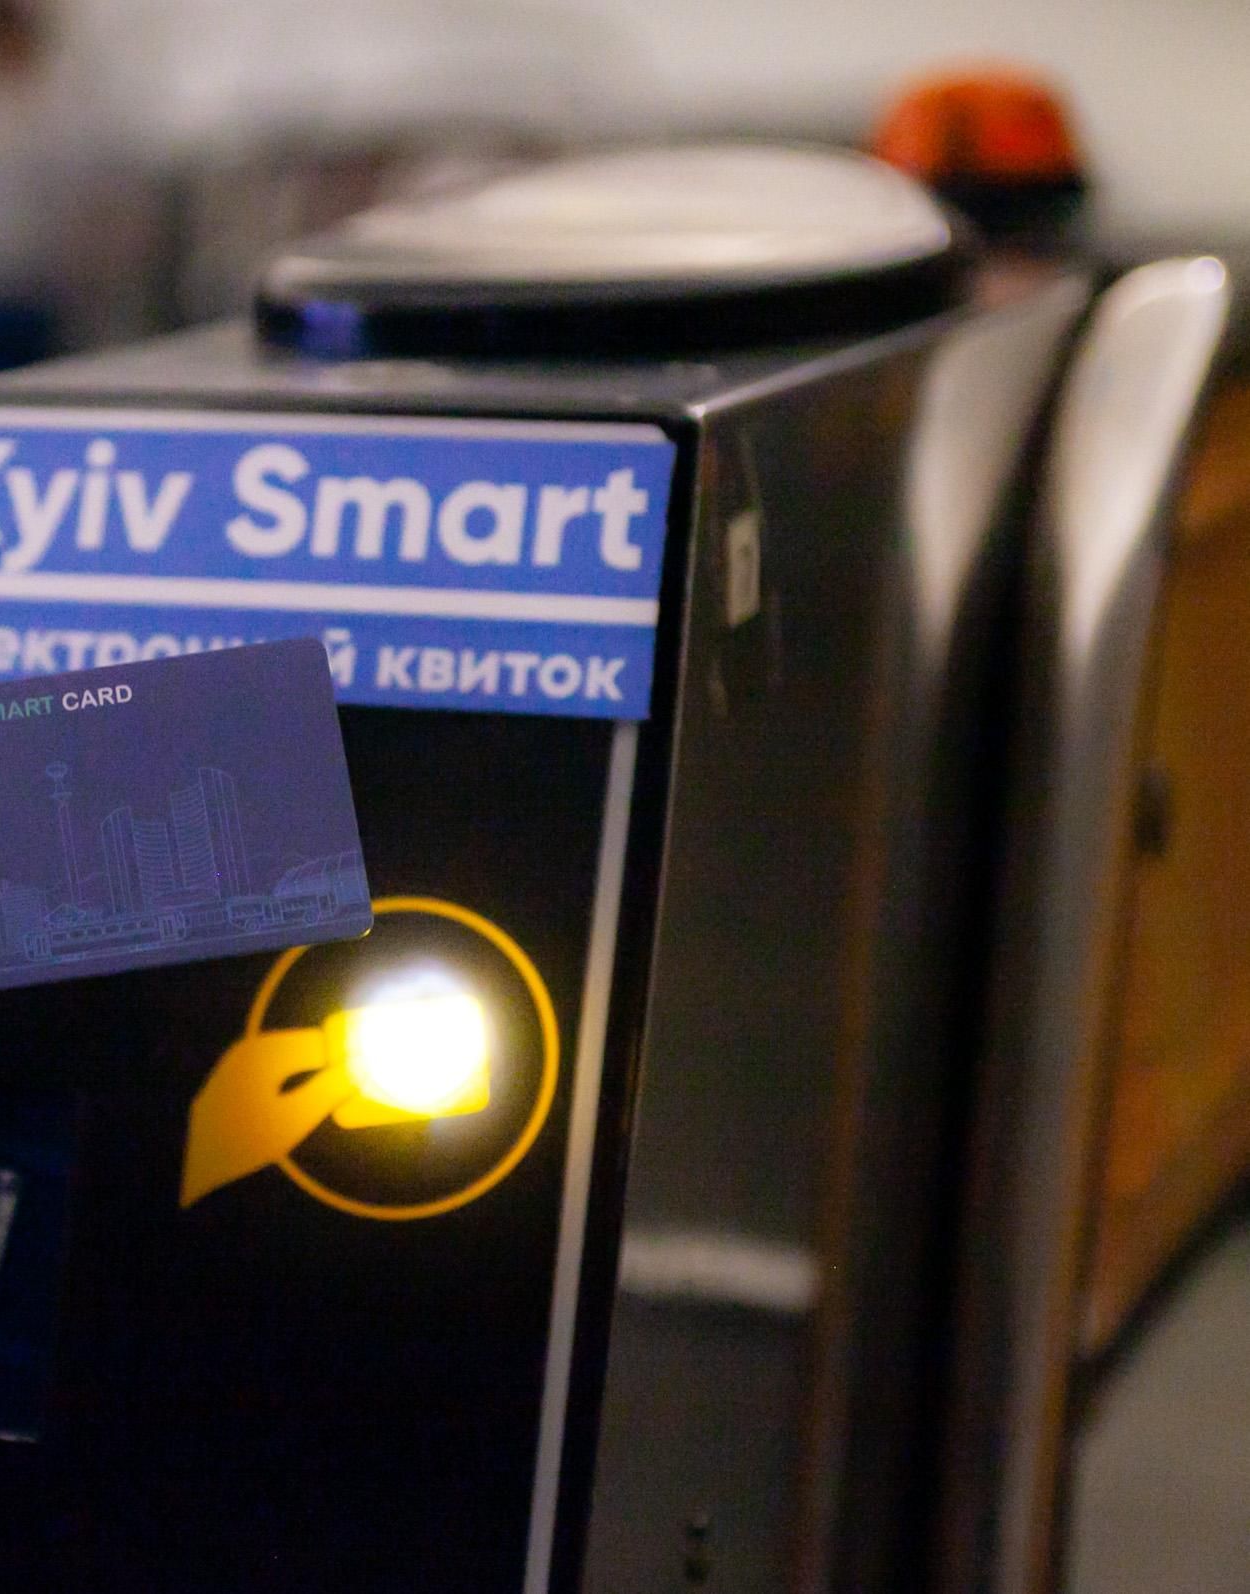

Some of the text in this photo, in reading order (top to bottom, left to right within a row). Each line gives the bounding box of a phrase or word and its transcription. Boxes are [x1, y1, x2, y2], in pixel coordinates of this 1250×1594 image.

[228, 443, 650, 571] Smart
[62, 684, 133, 712] CARD
[375, 646, 626, 701] квиток
